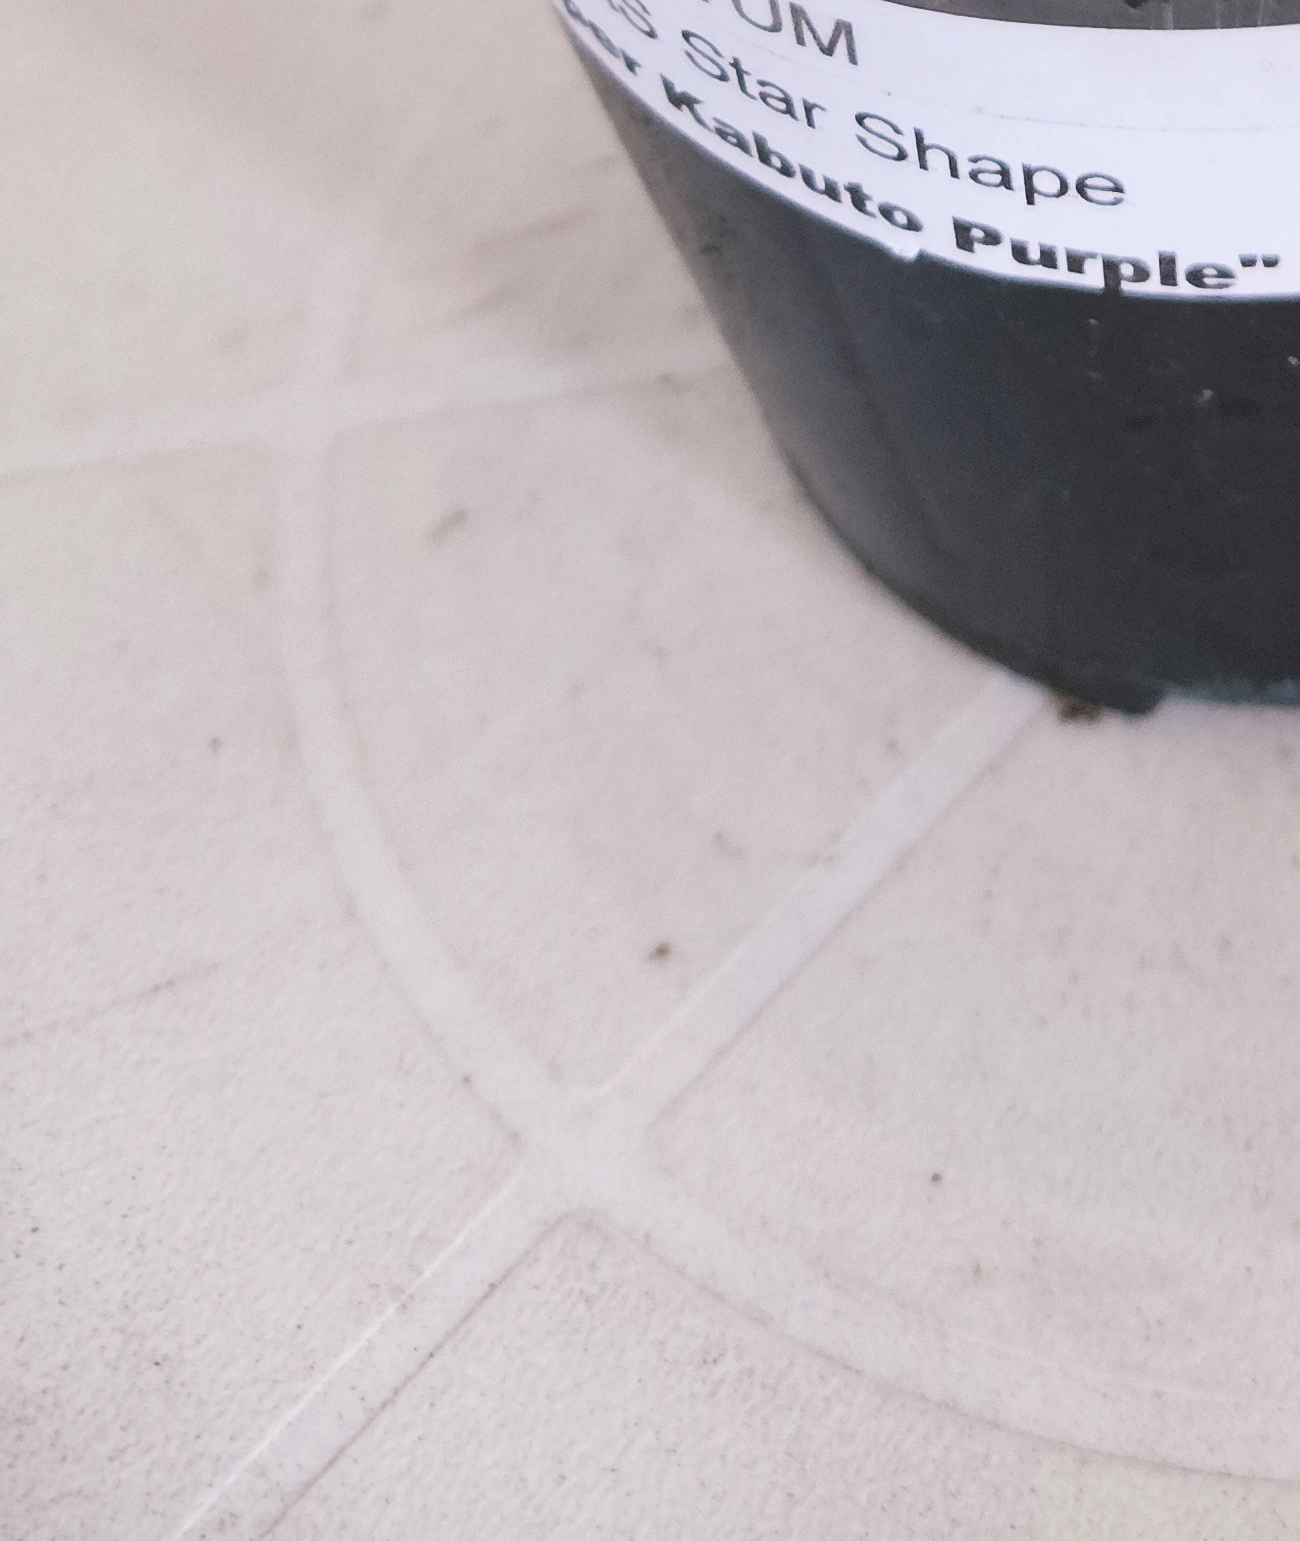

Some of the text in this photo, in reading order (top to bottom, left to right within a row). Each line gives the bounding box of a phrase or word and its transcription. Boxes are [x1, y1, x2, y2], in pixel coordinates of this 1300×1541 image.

[659, 70, 925, 234] Kabuto
[681, 26, 827, 130] Star
[854, 110, 1127, 208] Shape
